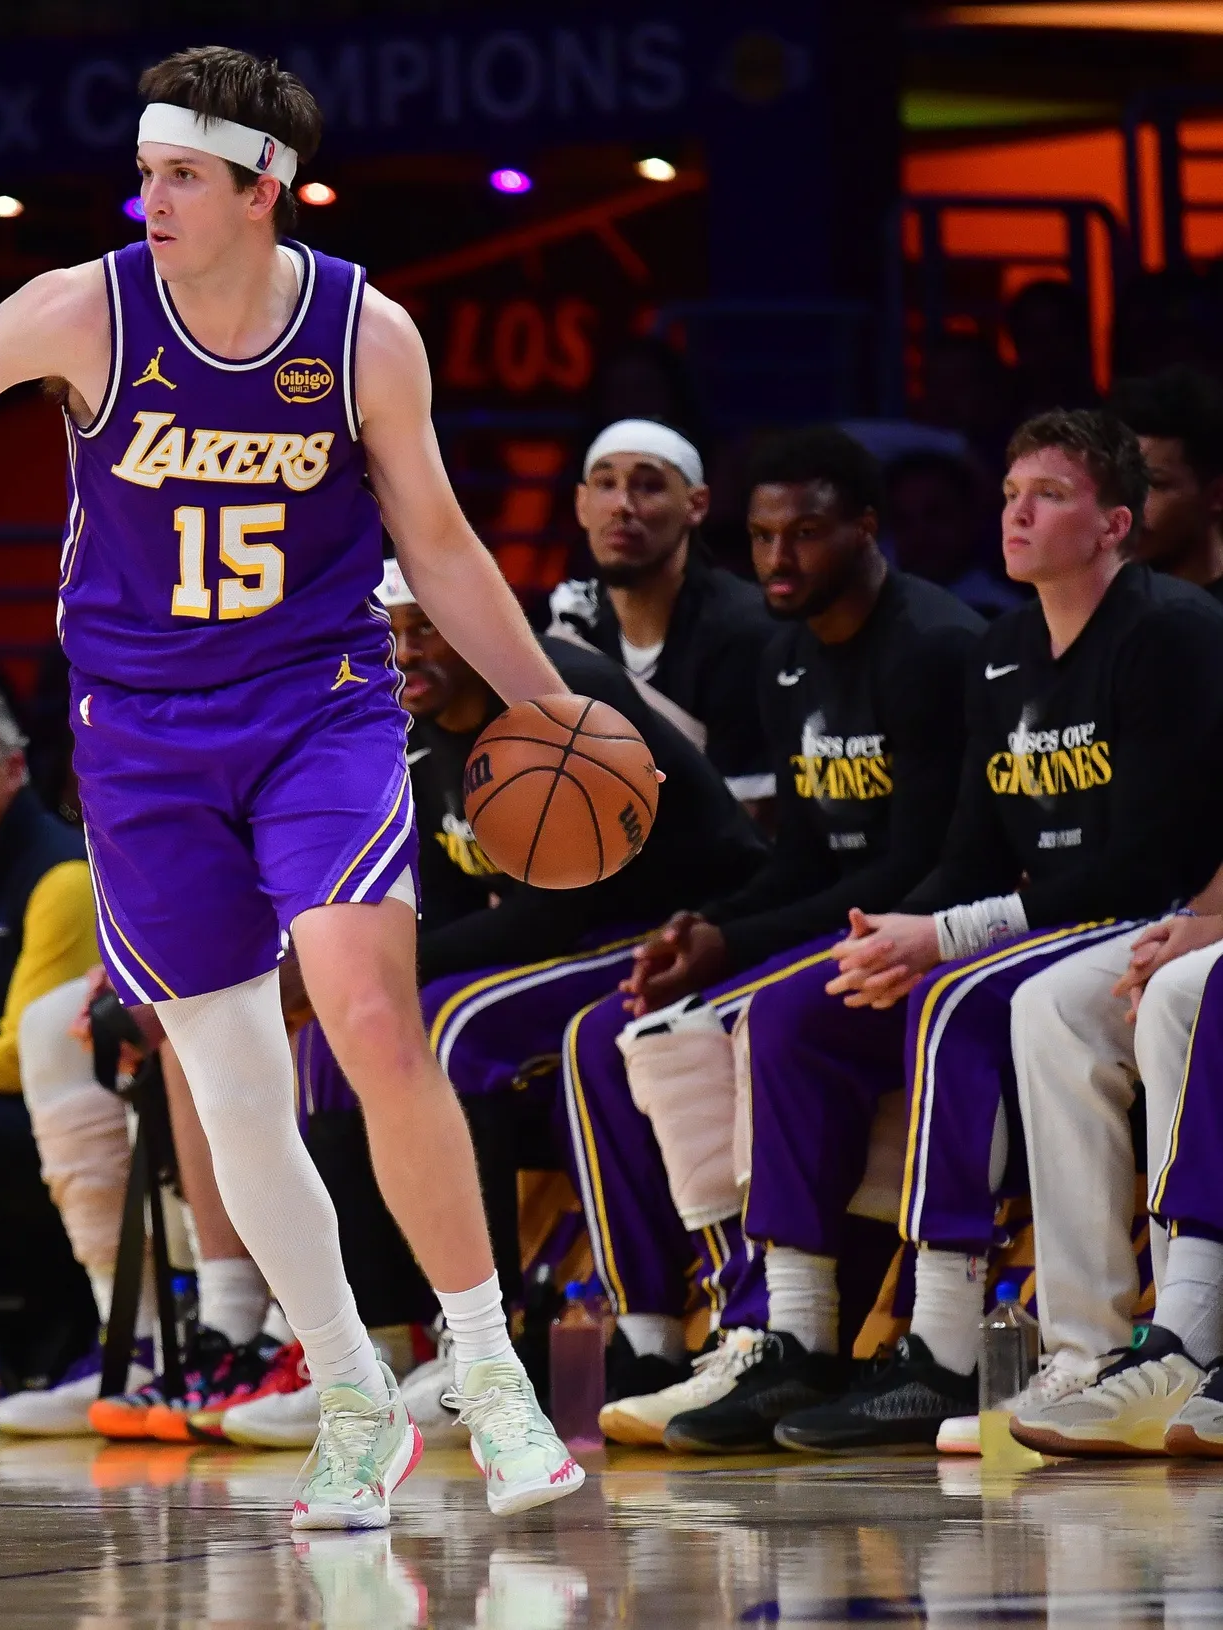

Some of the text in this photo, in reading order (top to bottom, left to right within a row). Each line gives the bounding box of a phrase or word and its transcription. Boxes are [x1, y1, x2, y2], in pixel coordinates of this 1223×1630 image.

[63, 20, 686, 148] CMPIONS
[280, 370, 331, 390] bibigo
[442, 297, 596, 391] LOS
[288, 385, 310, 393] 비비고
[111, 411, 335, 491] LAKERS
[171, 503, 286, 620] 15
